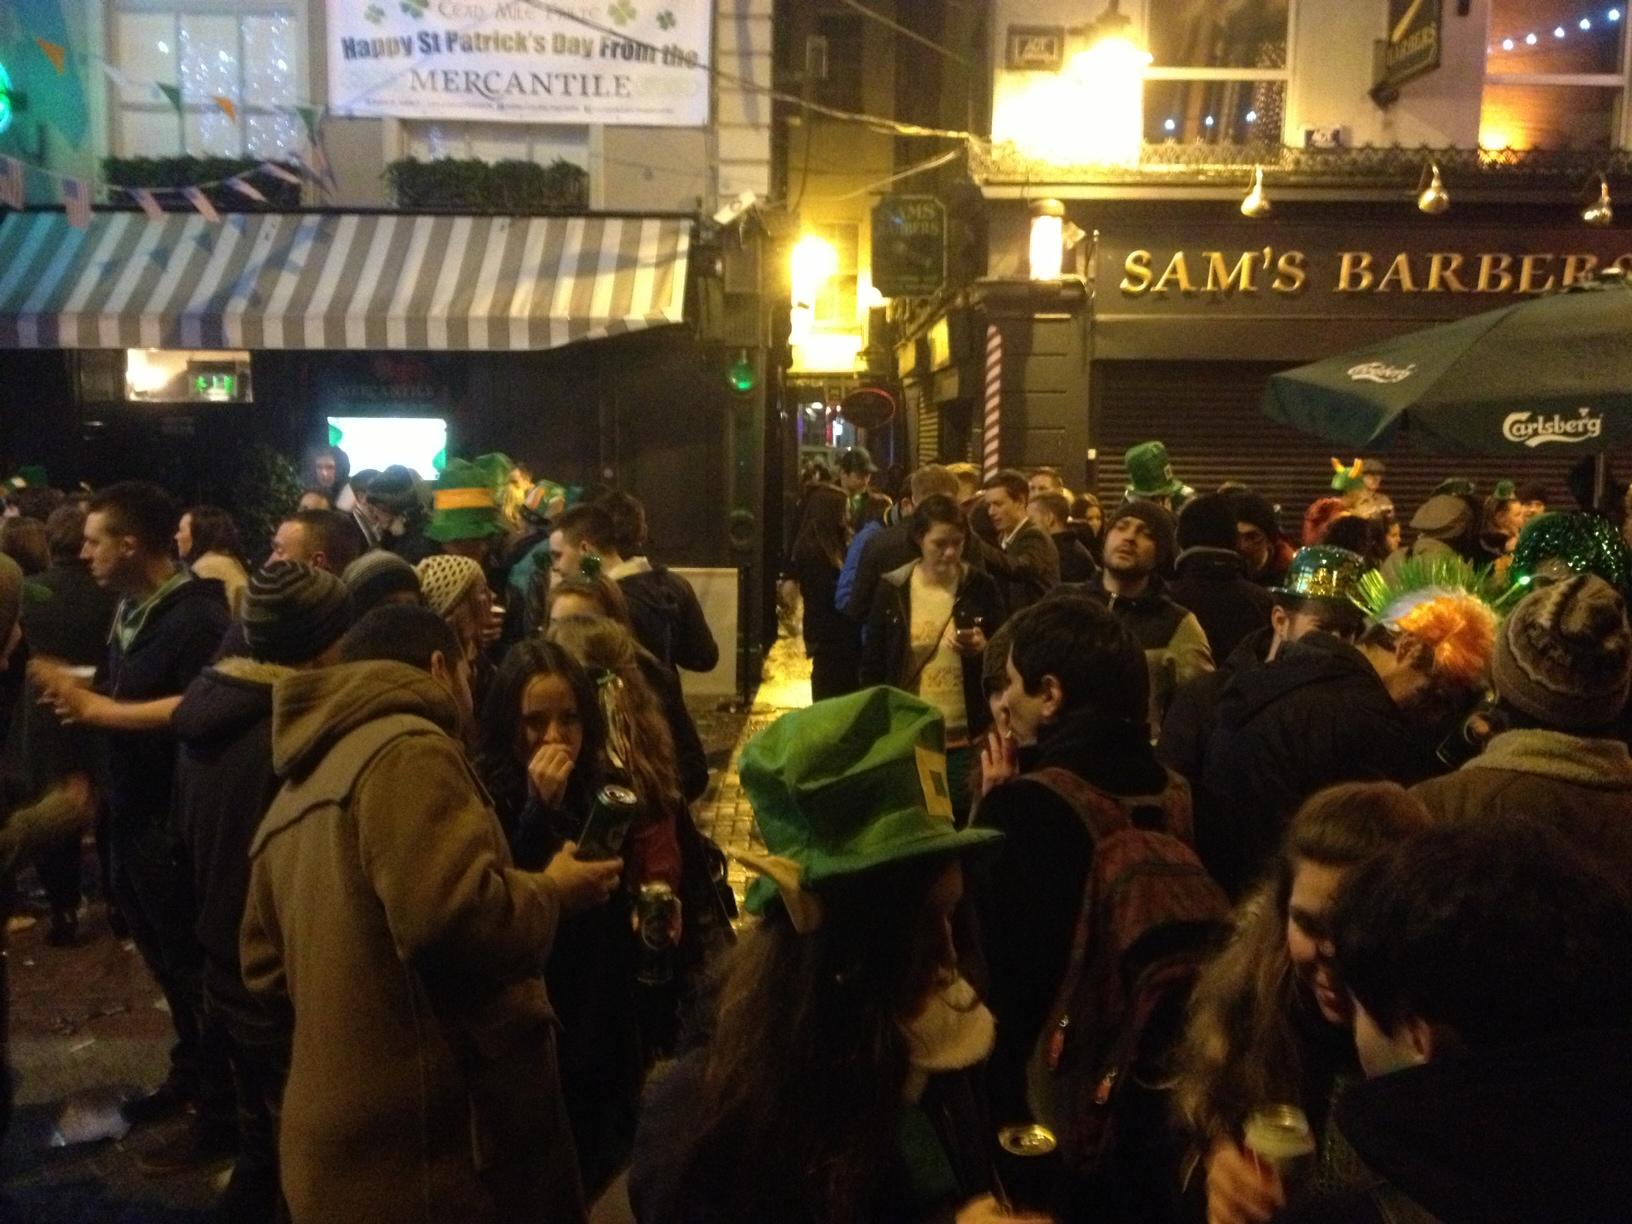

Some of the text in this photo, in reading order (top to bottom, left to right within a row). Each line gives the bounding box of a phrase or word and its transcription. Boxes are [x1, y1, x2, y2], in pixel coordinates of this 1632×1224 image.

[341, 29, 699, 69] Happy St Patrick's Day From the
[410, 68, 632, 100] MERCANTILE
[1120, 247, 1306, 292] SAM'S
[1503, 408, 1602, 445] Carlsberg
